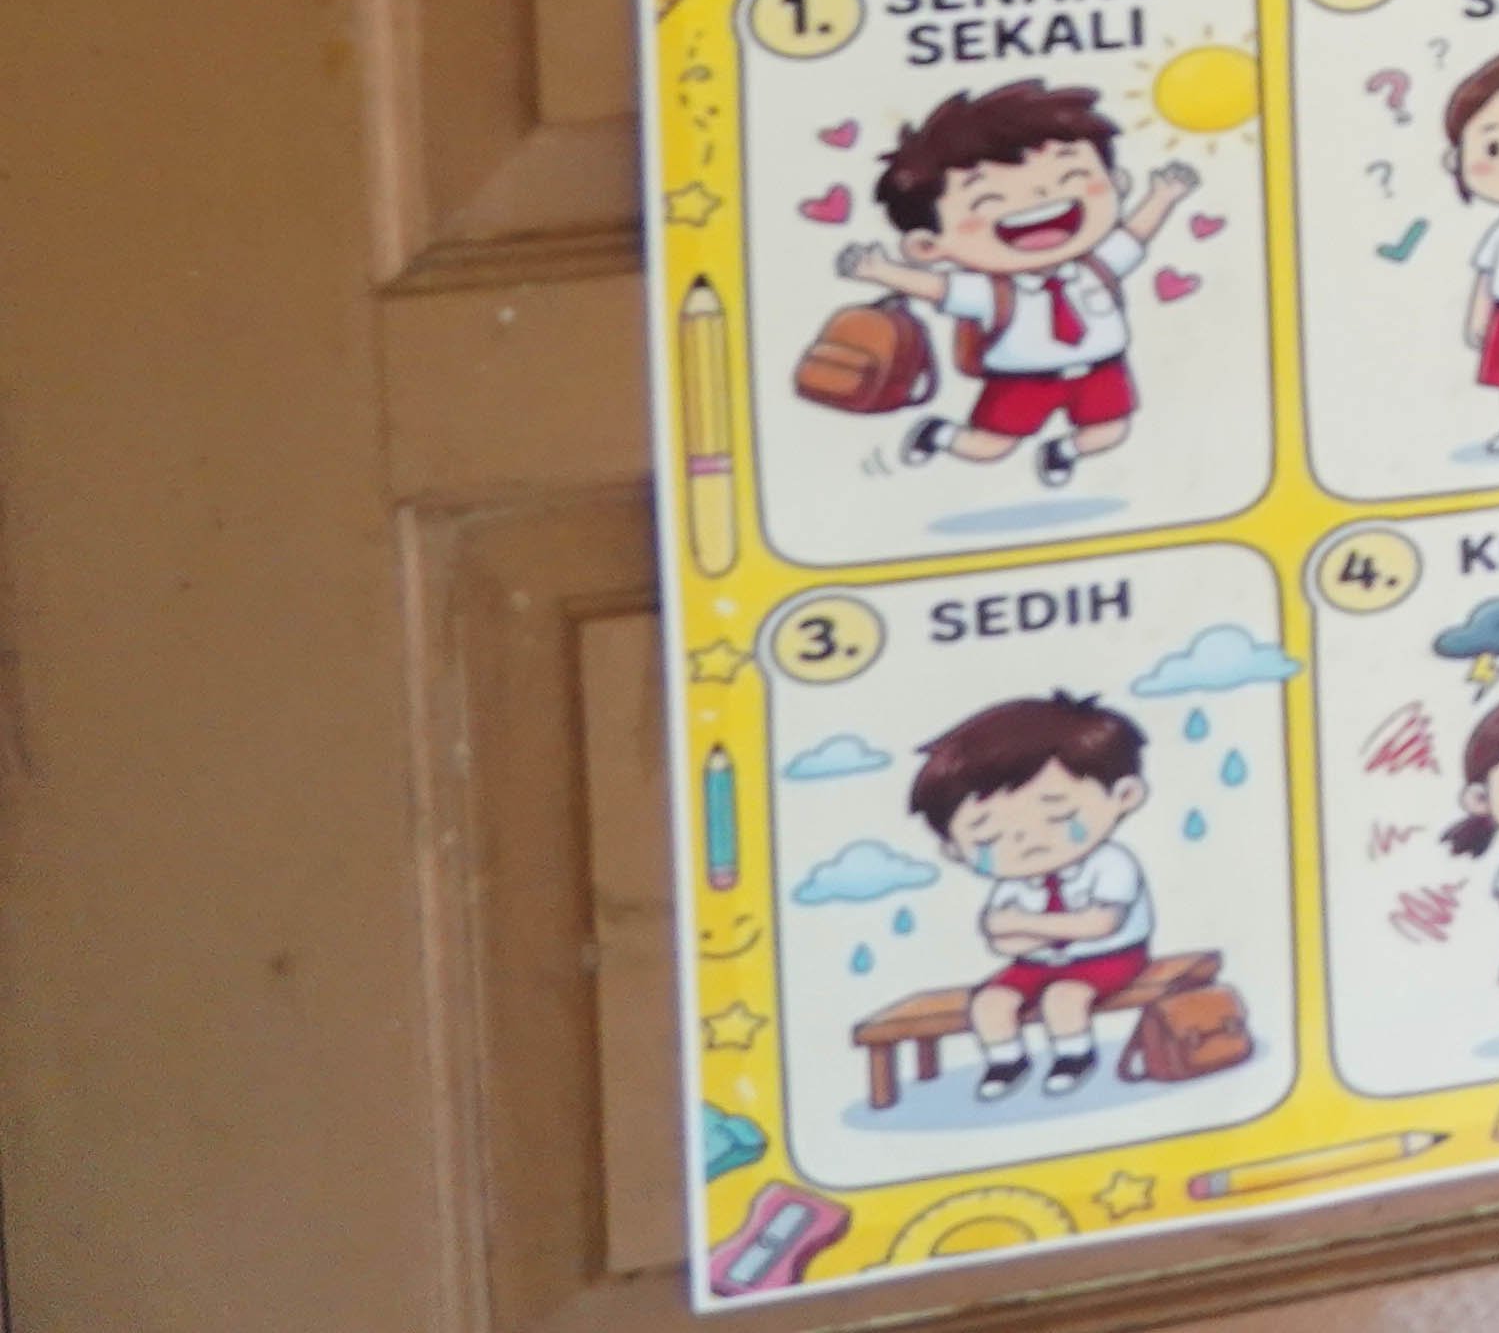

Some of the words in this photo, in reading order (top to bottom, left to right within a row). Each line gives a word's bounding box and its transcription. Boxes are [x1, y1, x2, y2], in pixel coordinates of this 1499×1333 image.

[907, 7, 1143, 67] SEKALI
[1340, 550, 1400, 592] 4.
[798, 617, 860, 662] 3.
[929, 581, 1133, 642] SEDIH
